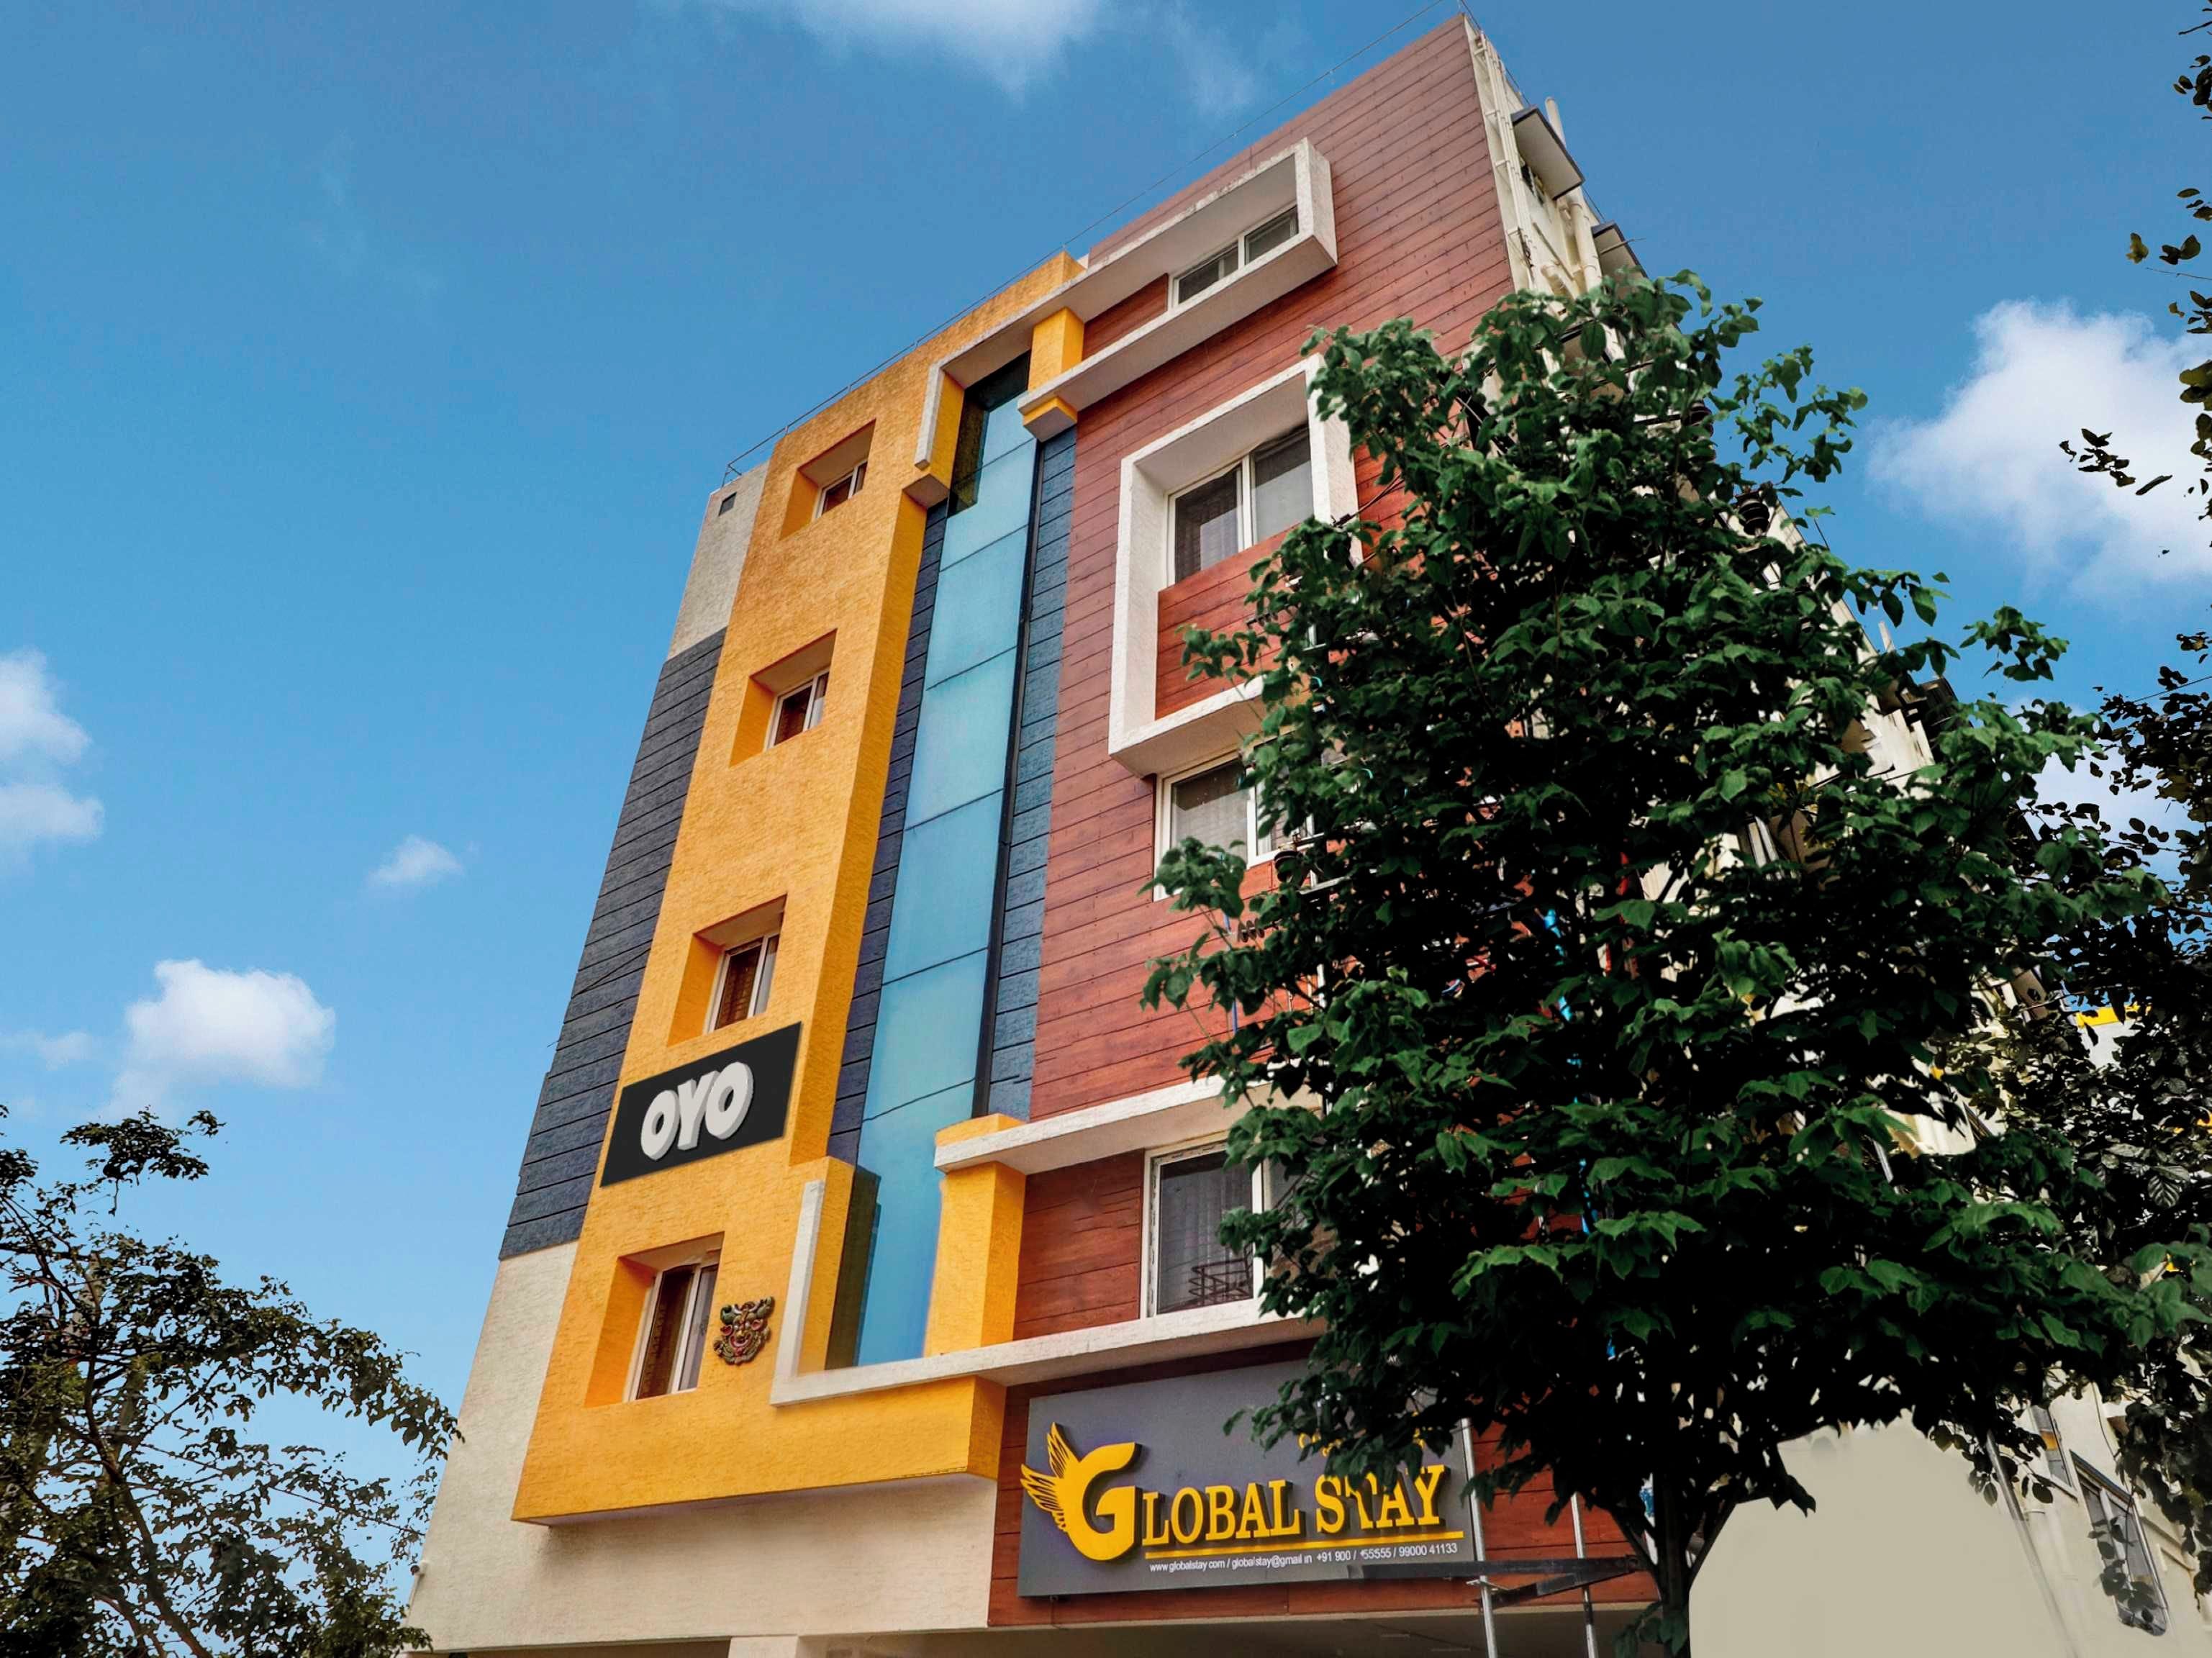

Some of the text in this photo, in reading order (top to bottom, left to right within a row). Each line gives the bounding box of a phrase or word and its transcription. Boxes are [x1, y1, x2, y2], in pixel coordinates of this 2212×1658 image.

[640, 1061, 753, 1161] OYO
[1020, 1422, 1300, 1561] GLOBAL
[1315, 1464, 1444, 1534] STAY
[1150, 1559, 1225, 1573] wwwglobalstaycom
[1232, 1554, 1312, 1570] globalstay@gmailin
[1316, 1551, 1332, 1562] +91
[1398, 1544, 1427, 1557] 99000
[1429, 1542, 1457, 1555] 41133
